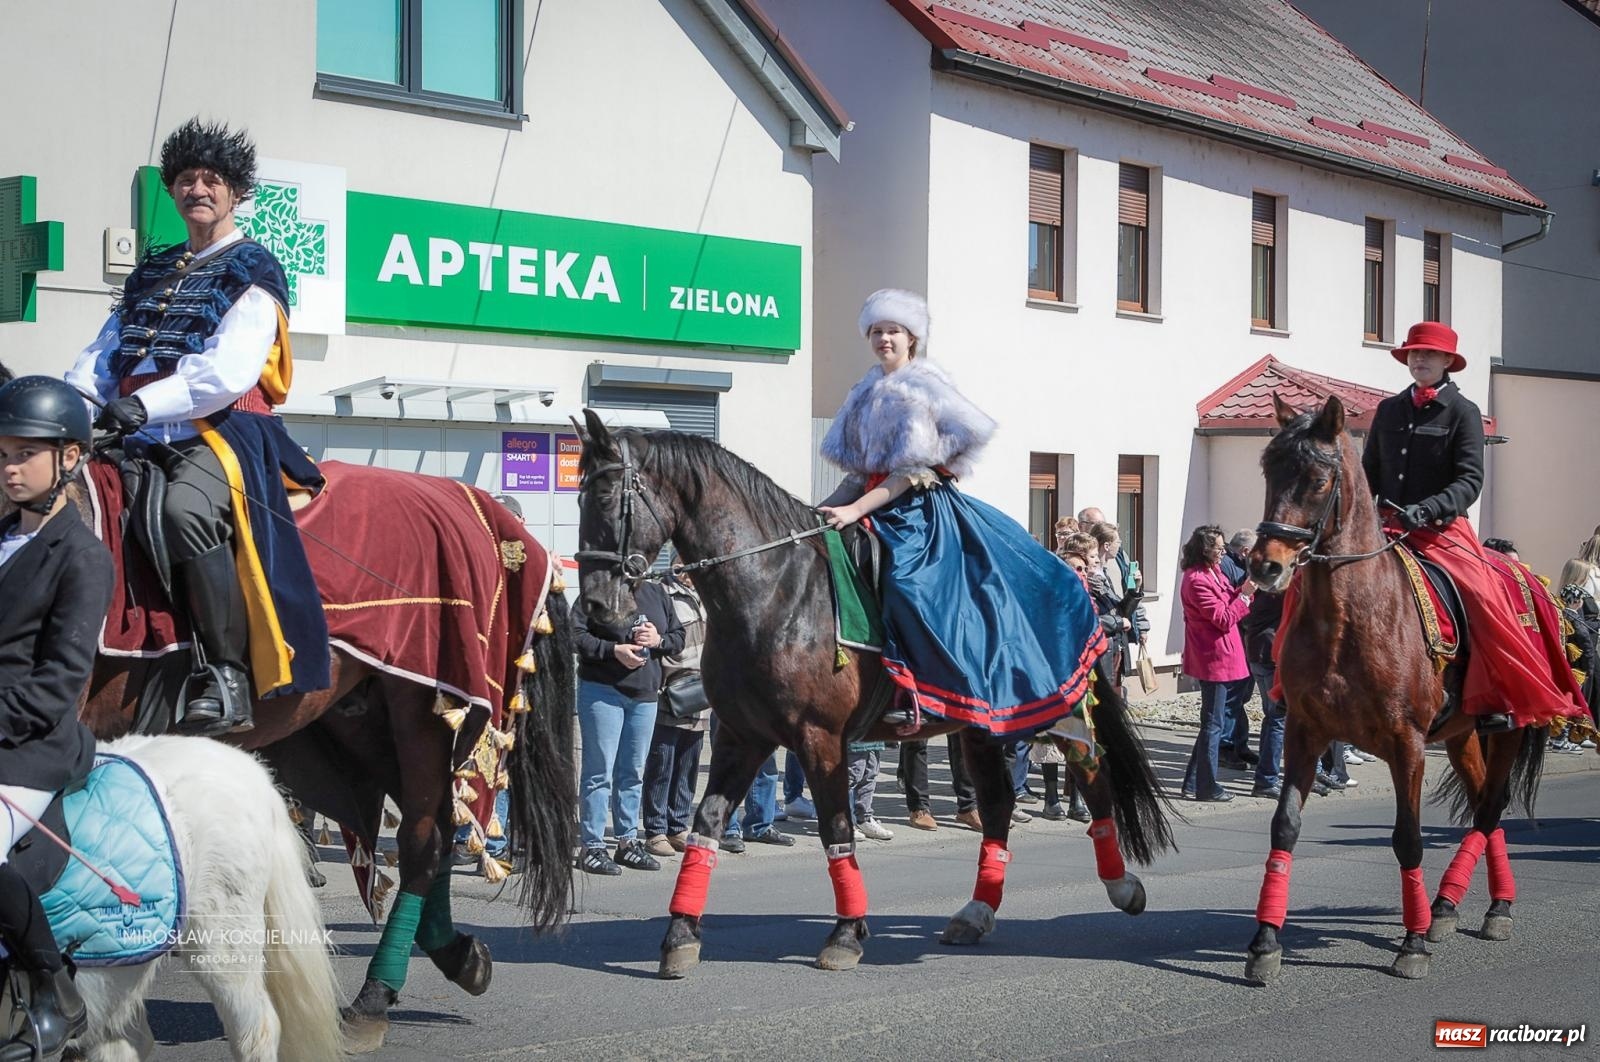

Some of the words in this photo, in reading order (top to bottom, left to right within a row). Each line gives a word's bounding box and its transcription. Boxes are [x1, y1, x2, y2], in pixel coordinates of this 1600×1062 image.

[377, 233, 621, 304] APTEKA
[669, 286, 780, 319] ZIELONA
[507, 438, 537, 451] allegro
